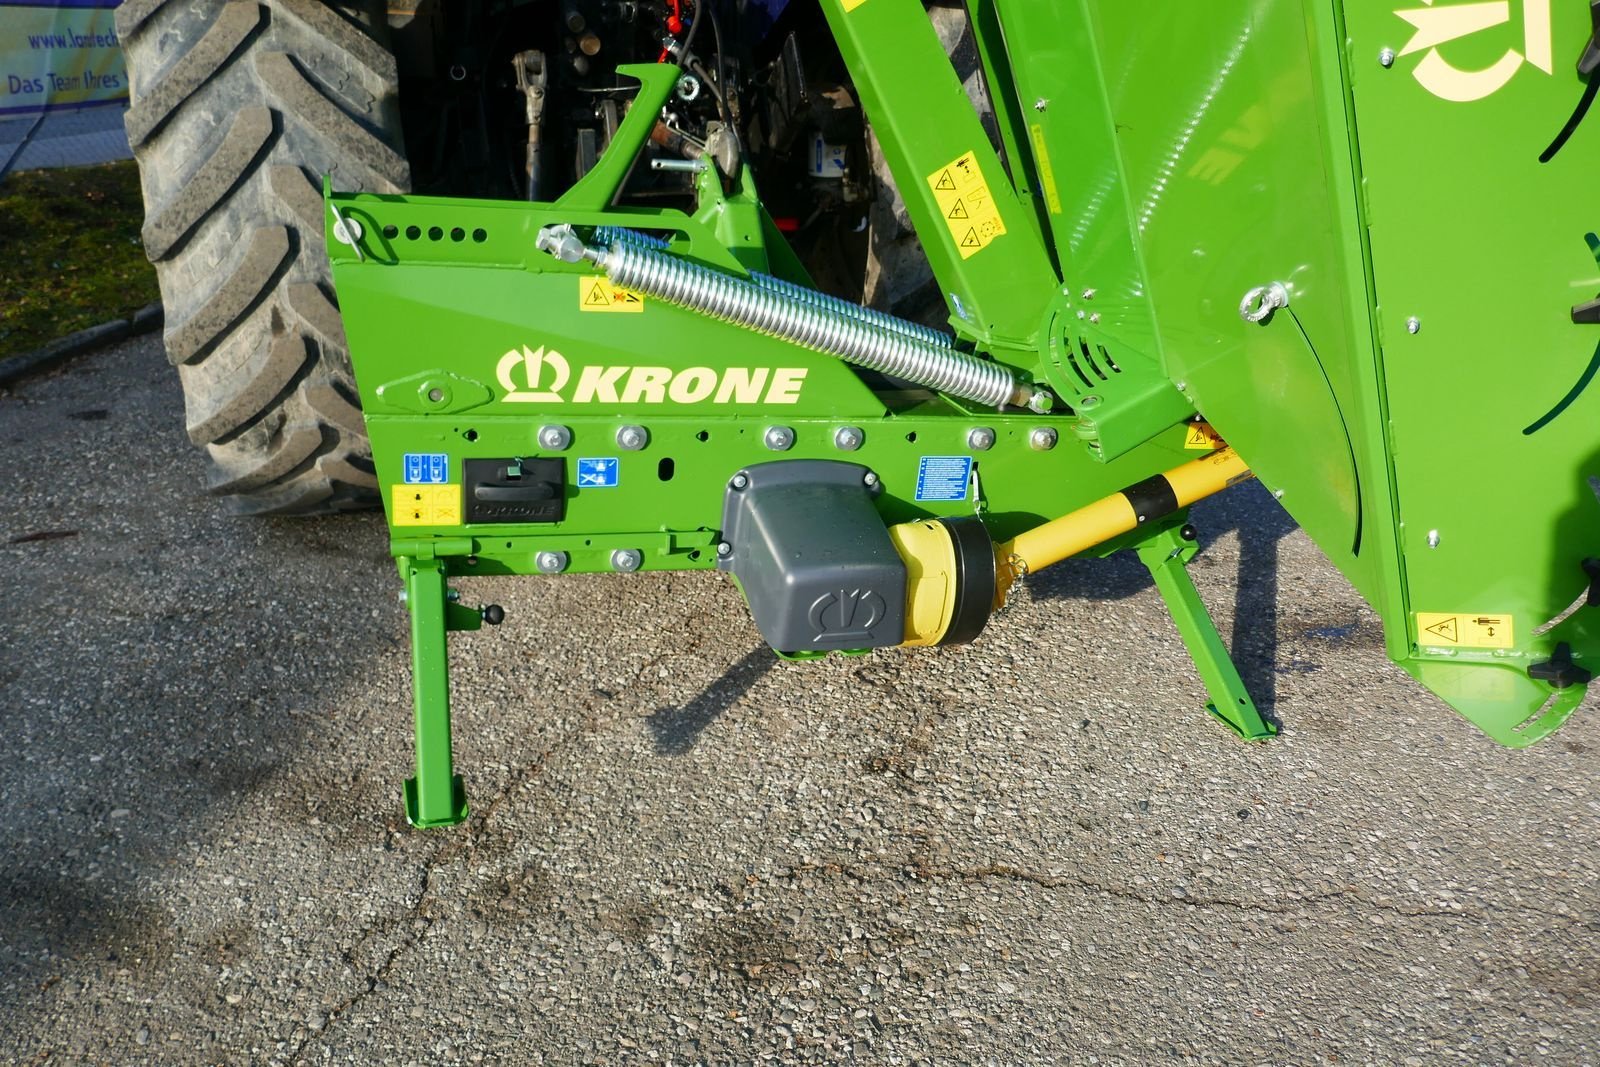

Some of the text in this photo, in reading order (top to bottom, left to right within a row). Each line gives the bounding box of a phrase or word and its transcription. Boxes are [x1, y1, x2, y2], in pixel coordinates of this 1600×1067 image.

[8, 74, 44, 95] Das
[47, 73, 80, 92] Team
[84, 70, 120, 90] Ihres
[572, 365, 808, 404] KRONE
